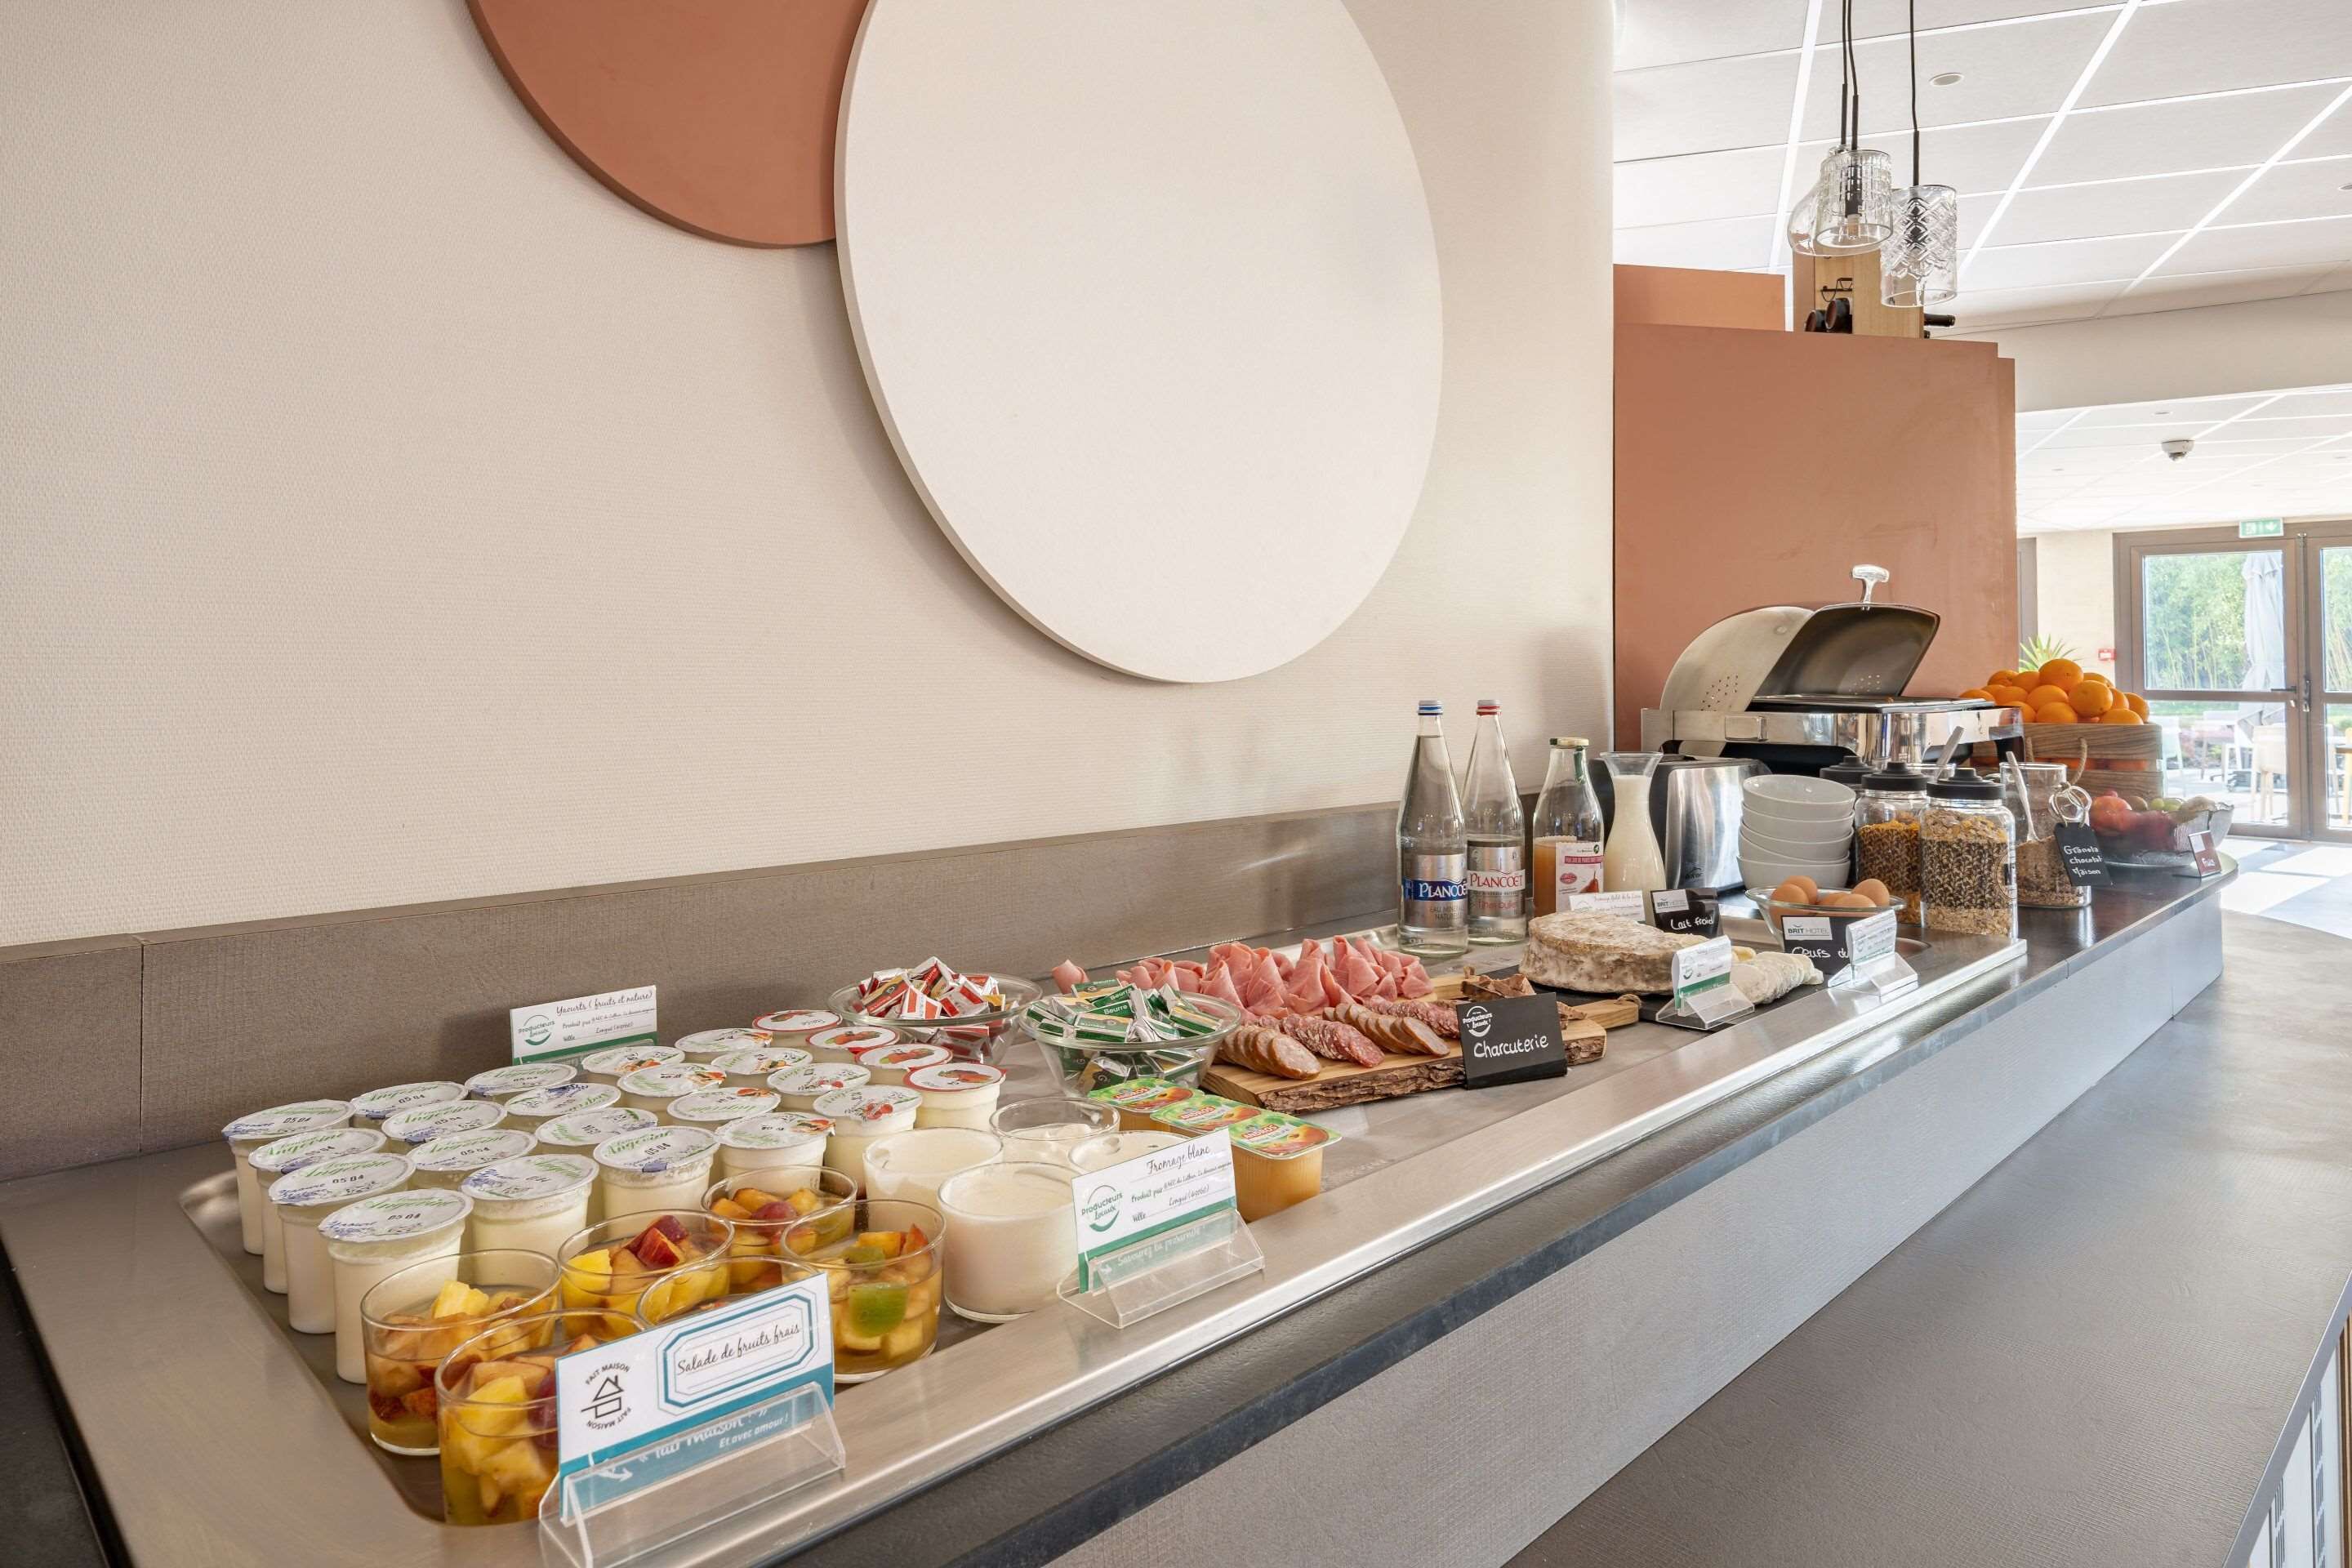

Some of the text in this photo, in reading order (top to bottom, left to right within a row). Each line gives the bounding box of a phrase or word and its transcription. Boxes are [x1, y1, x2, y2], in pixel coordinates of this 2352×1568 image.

[2064, 845, 2099, 855] Granola
[1670, 914, 1715, 930] Lait froid
[1103, 1004, 1128, 1014] Beurre
[1473, 1034, 1549, 1058] Charcuterie
[1244, 1124, 1279, 1140] ANDROS
[644, 1146, 660, 1156] 05
[1147, 1143, 1211, 1176] Fromage blanc
[677, 1323, 800, 1375] Salade de fruits frais
[585, 1361, 630, 1385] FAIT MAISON
[719, 1436, 730, 1450] Et
[732, 1429, 753, 1444] avec
